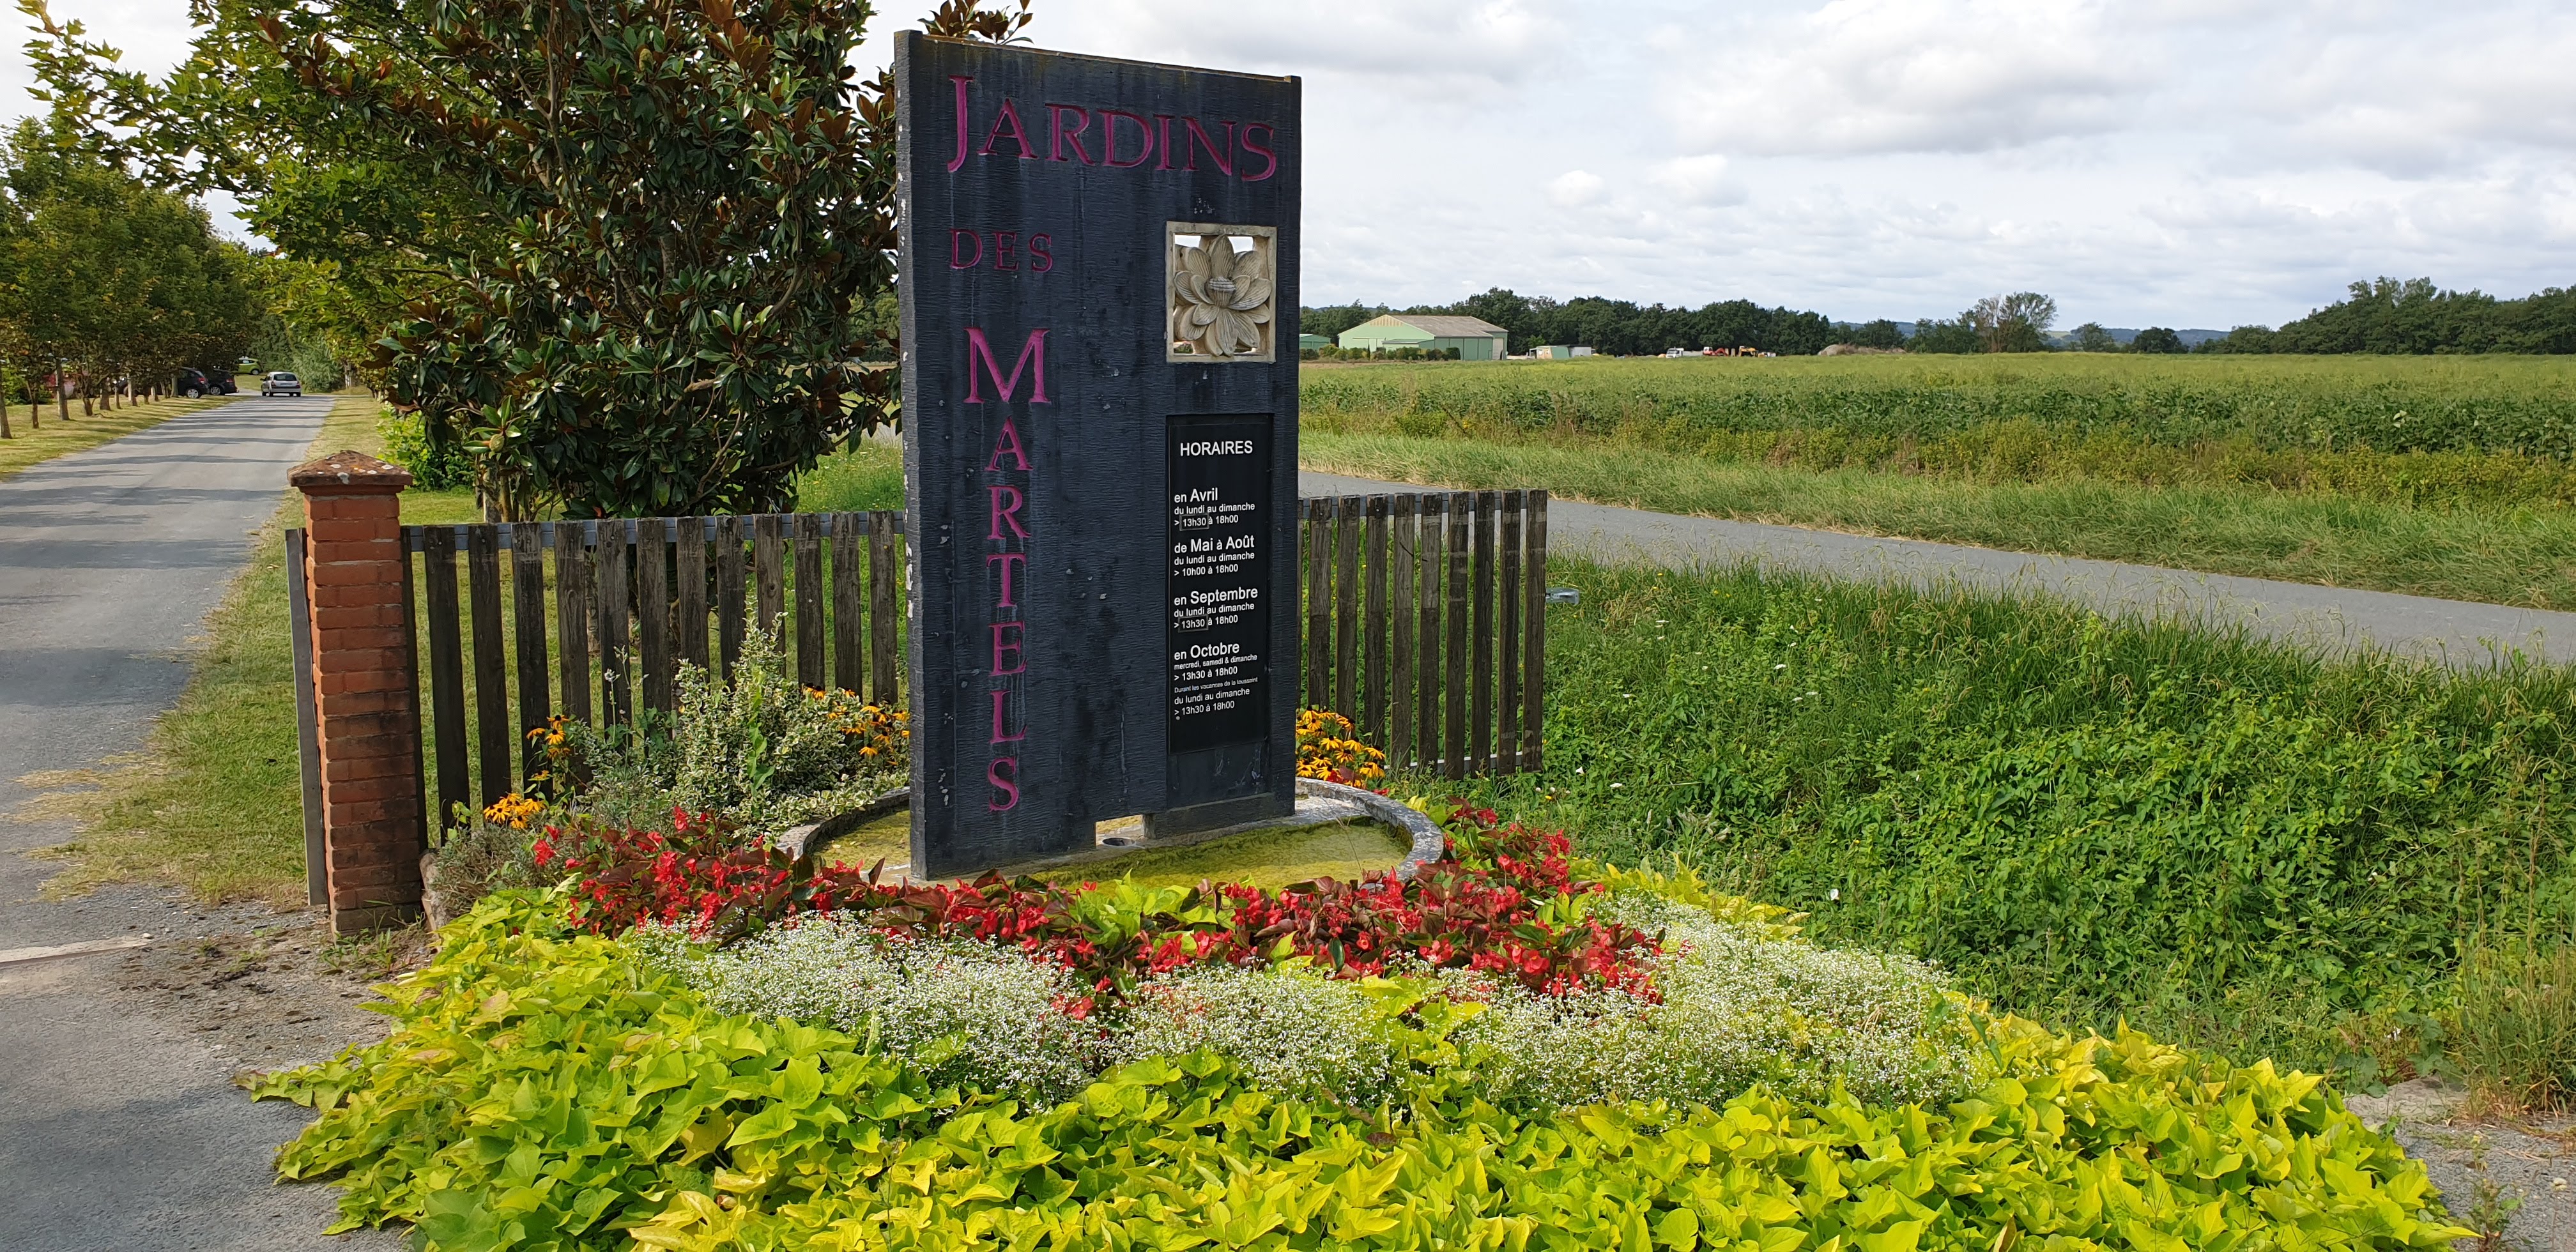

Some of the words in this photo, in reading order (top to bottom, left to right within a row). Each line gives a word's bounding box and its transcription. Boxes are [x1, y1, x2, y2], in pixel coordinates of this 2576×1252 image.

[947, 74, 1277, 181] JARDINS
[949, 228, 1053, 273] DES
[1180, 440, 1253, 456] HORAIRES
[1174, 494, 1186, 503] en
[1190, 488, 1218, 501] Avril
[1174, 507, 1184, 515] du
[1186, 505, 1205, 514] lundi
[1219, 503, 1255, 512] dimanche
[1183, 517, 1206, 526] 13h30
[1216, 515, 1238, 524] 18h00
[1174, 542, 1187, 553] de
[1191, 538, 1213, 552] Mai
[1216, 540, 1222, 550] à
[1225, 535, 1254, 549] Août
[1174, 557, 1184, 565] du
[1186, 555, 1205, 564] lundi
[1219, 552, 1255, 561] dimanche
[963, 326, 1051, 812] MARTELS
[1183, 567, 1206, 576] 10h00
[1216, 564, 1238, 573] 18h00
[1174, 596, 1186, 606] en
[1190, 587, 1258, 606] Septembre
[1174, 609, 1183, 618] du
[1186, 607, 1204, 616] lundi
[1219, 602, 1255, 613] dimanche
[1182, 619, 1205, 629] 13h30
[1215, 615, 1238, 624] 18h00
[1174, 651, 1186, 660] en
[1190, 642, 1239, 659] Octobre
[1230, 654, 1257, 663] dimanche
[1183, 671, 1205, 680] 13h30
[1215, 666, 1238, 676] 18h00
[1186, 694, 1202, 703] lundi
[1216, 688, 1250, 699] dimanche
[1182, 705, 1204, 715] 13h30
[1213, 701, 1234, 710] 18h00
